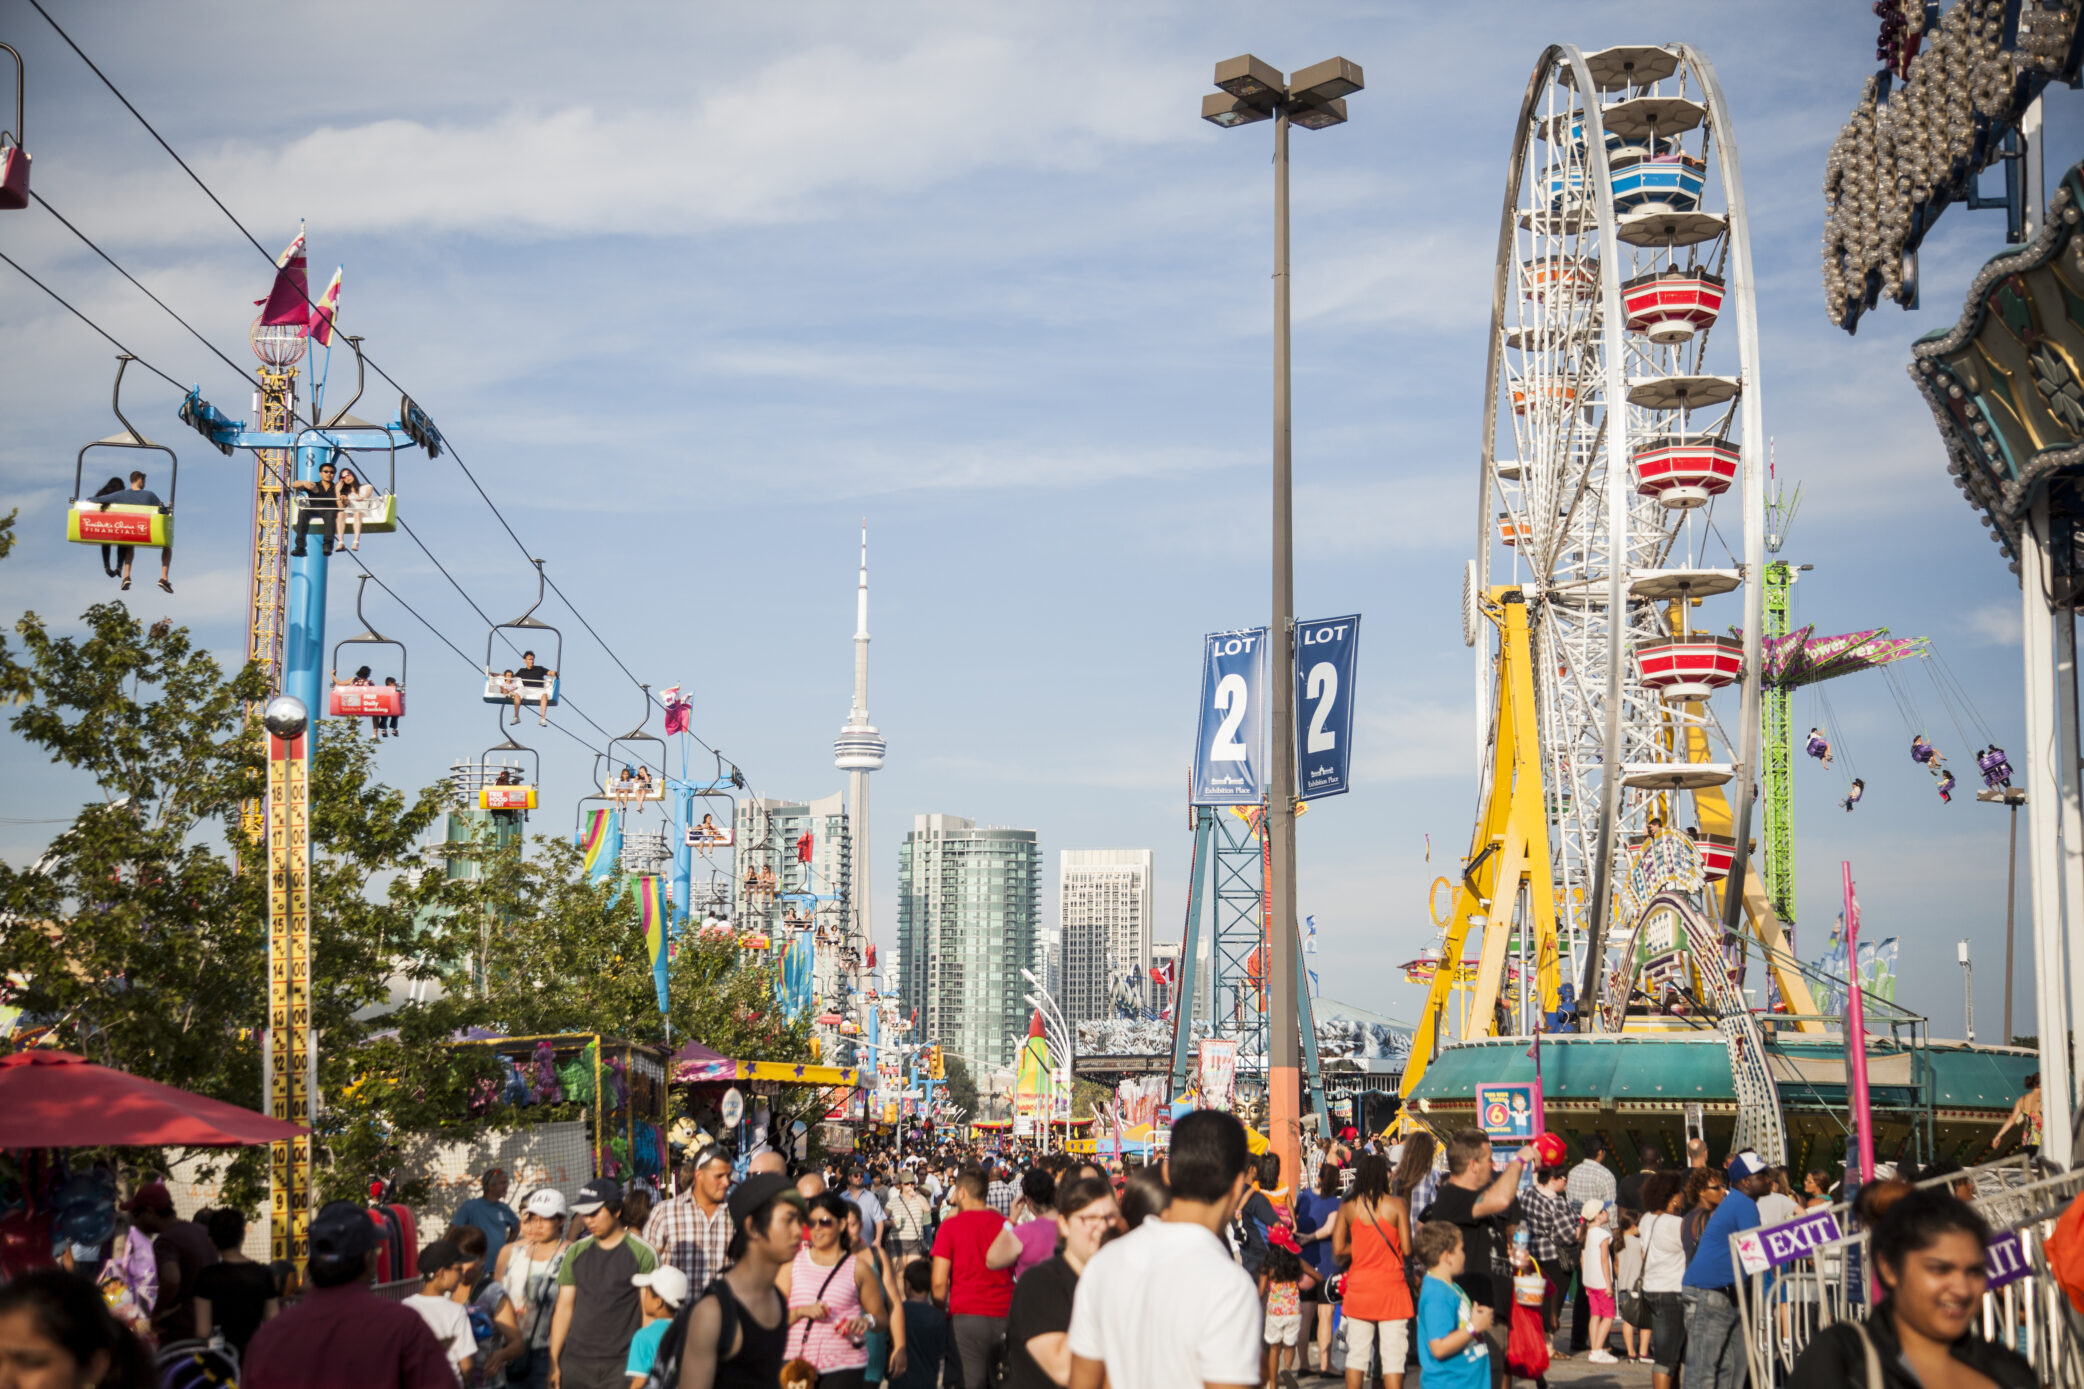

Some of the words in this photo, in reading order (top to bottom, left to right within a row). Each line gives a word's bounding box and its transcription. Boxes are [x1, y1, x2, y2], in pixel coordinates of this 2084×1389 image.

[310, 432, 318, 441] 8
[305, 452, 315, 467] 8
[85, 527, 136, 535] FINANCIAL
[1304, 625, 1348, 645] LOT
[1214, 637, 1256, 657] LOT
[363, 700, 379, 708] Daily
[1306, 661, 1338, 754] 2
[1210, 673, 1248, 762] 2
[1204, 786, 1234, 794] Exhibition
[1235, 786, 1251, 794] Place
[1307, 779, 1328, 788] Exhibition
[1328, 776, 1339, 784] Place
[1491, 1106, 1504, 1123] 6
[276, 1193, 284, 1210] 9
[1765, 1216, 1832, 1259] EXIT
